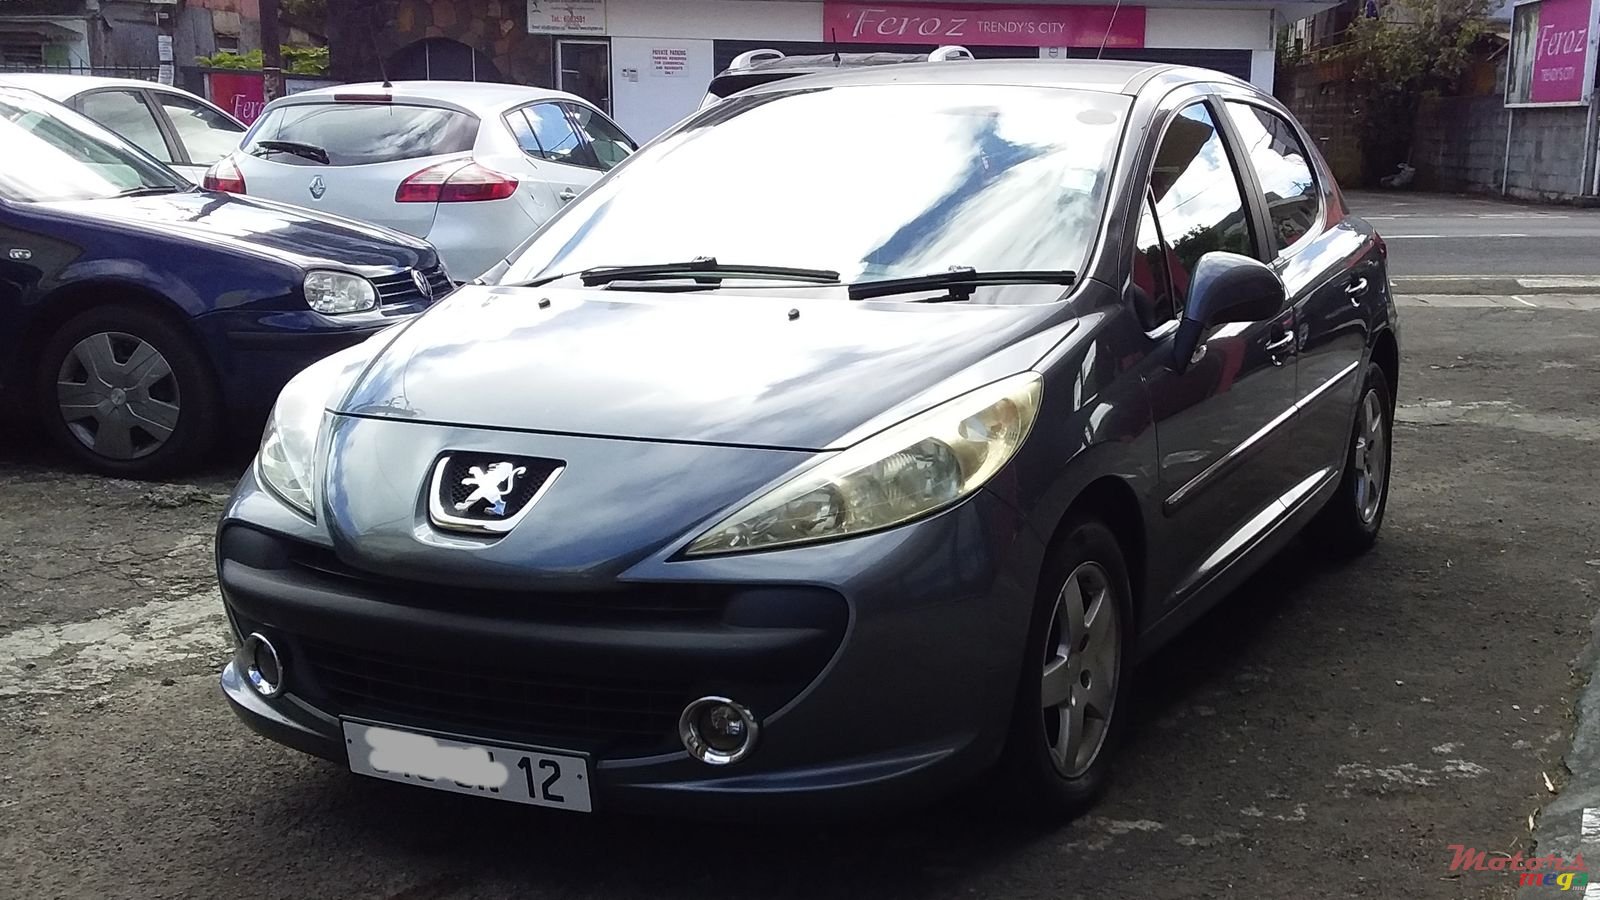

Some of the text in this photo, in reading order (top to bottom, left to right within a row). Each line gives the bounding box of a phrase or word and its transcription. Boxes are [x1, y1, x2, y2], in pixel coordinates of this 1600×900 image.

[846, 7, 1066, 38] Feroz TRENDY'S CITY
[1537, 24, 1587, 61] Feroz
[517, 756, 565, 803] 12
